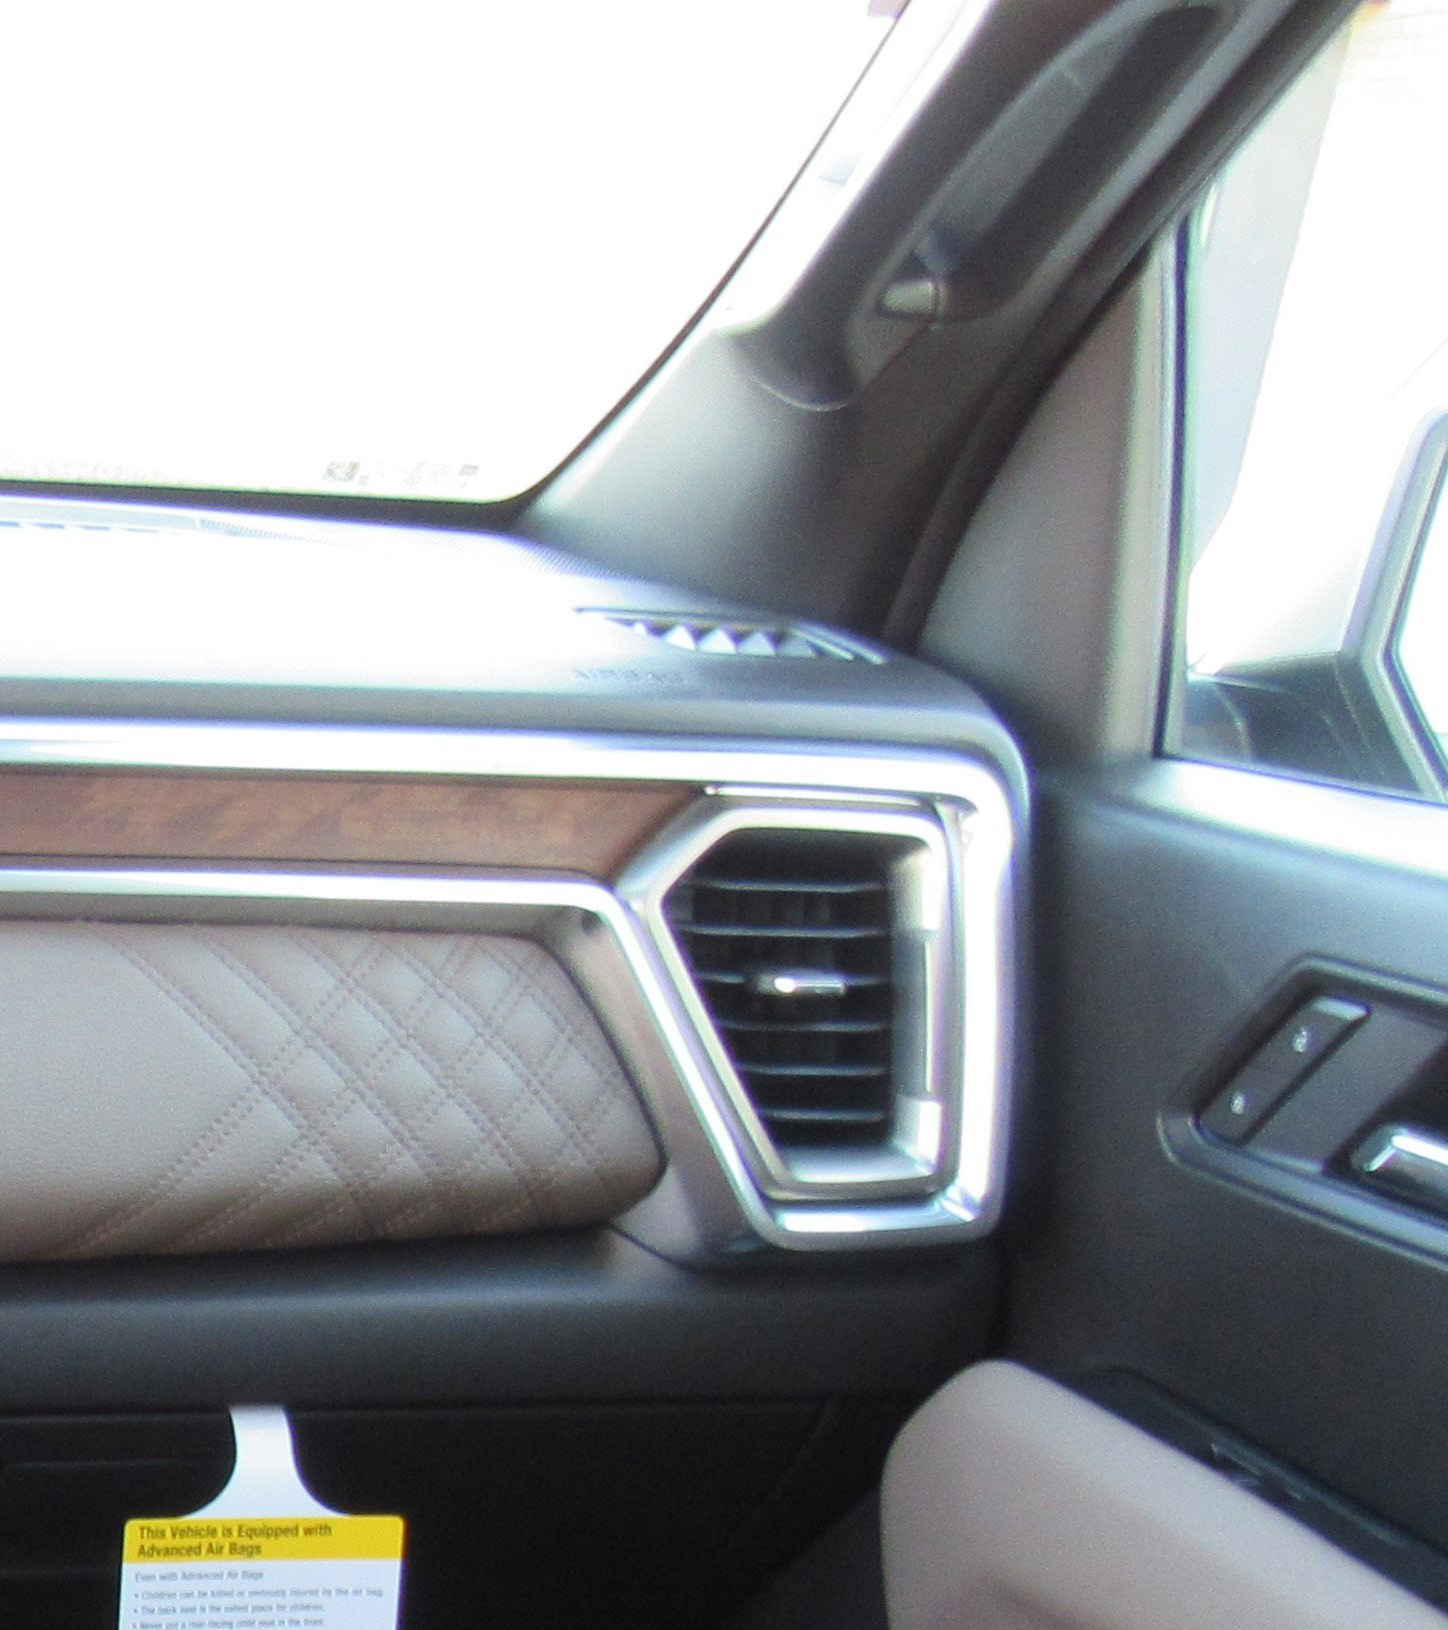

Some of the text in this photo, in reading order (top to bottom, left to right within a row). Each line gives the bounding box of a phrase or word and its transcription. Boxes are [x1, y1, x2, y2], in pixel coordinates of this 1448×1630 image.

[139, 1523, 332, 1541] This Vehicle is Equipped with
[137, 1541, 262, 1559] Advanced Air Bags
